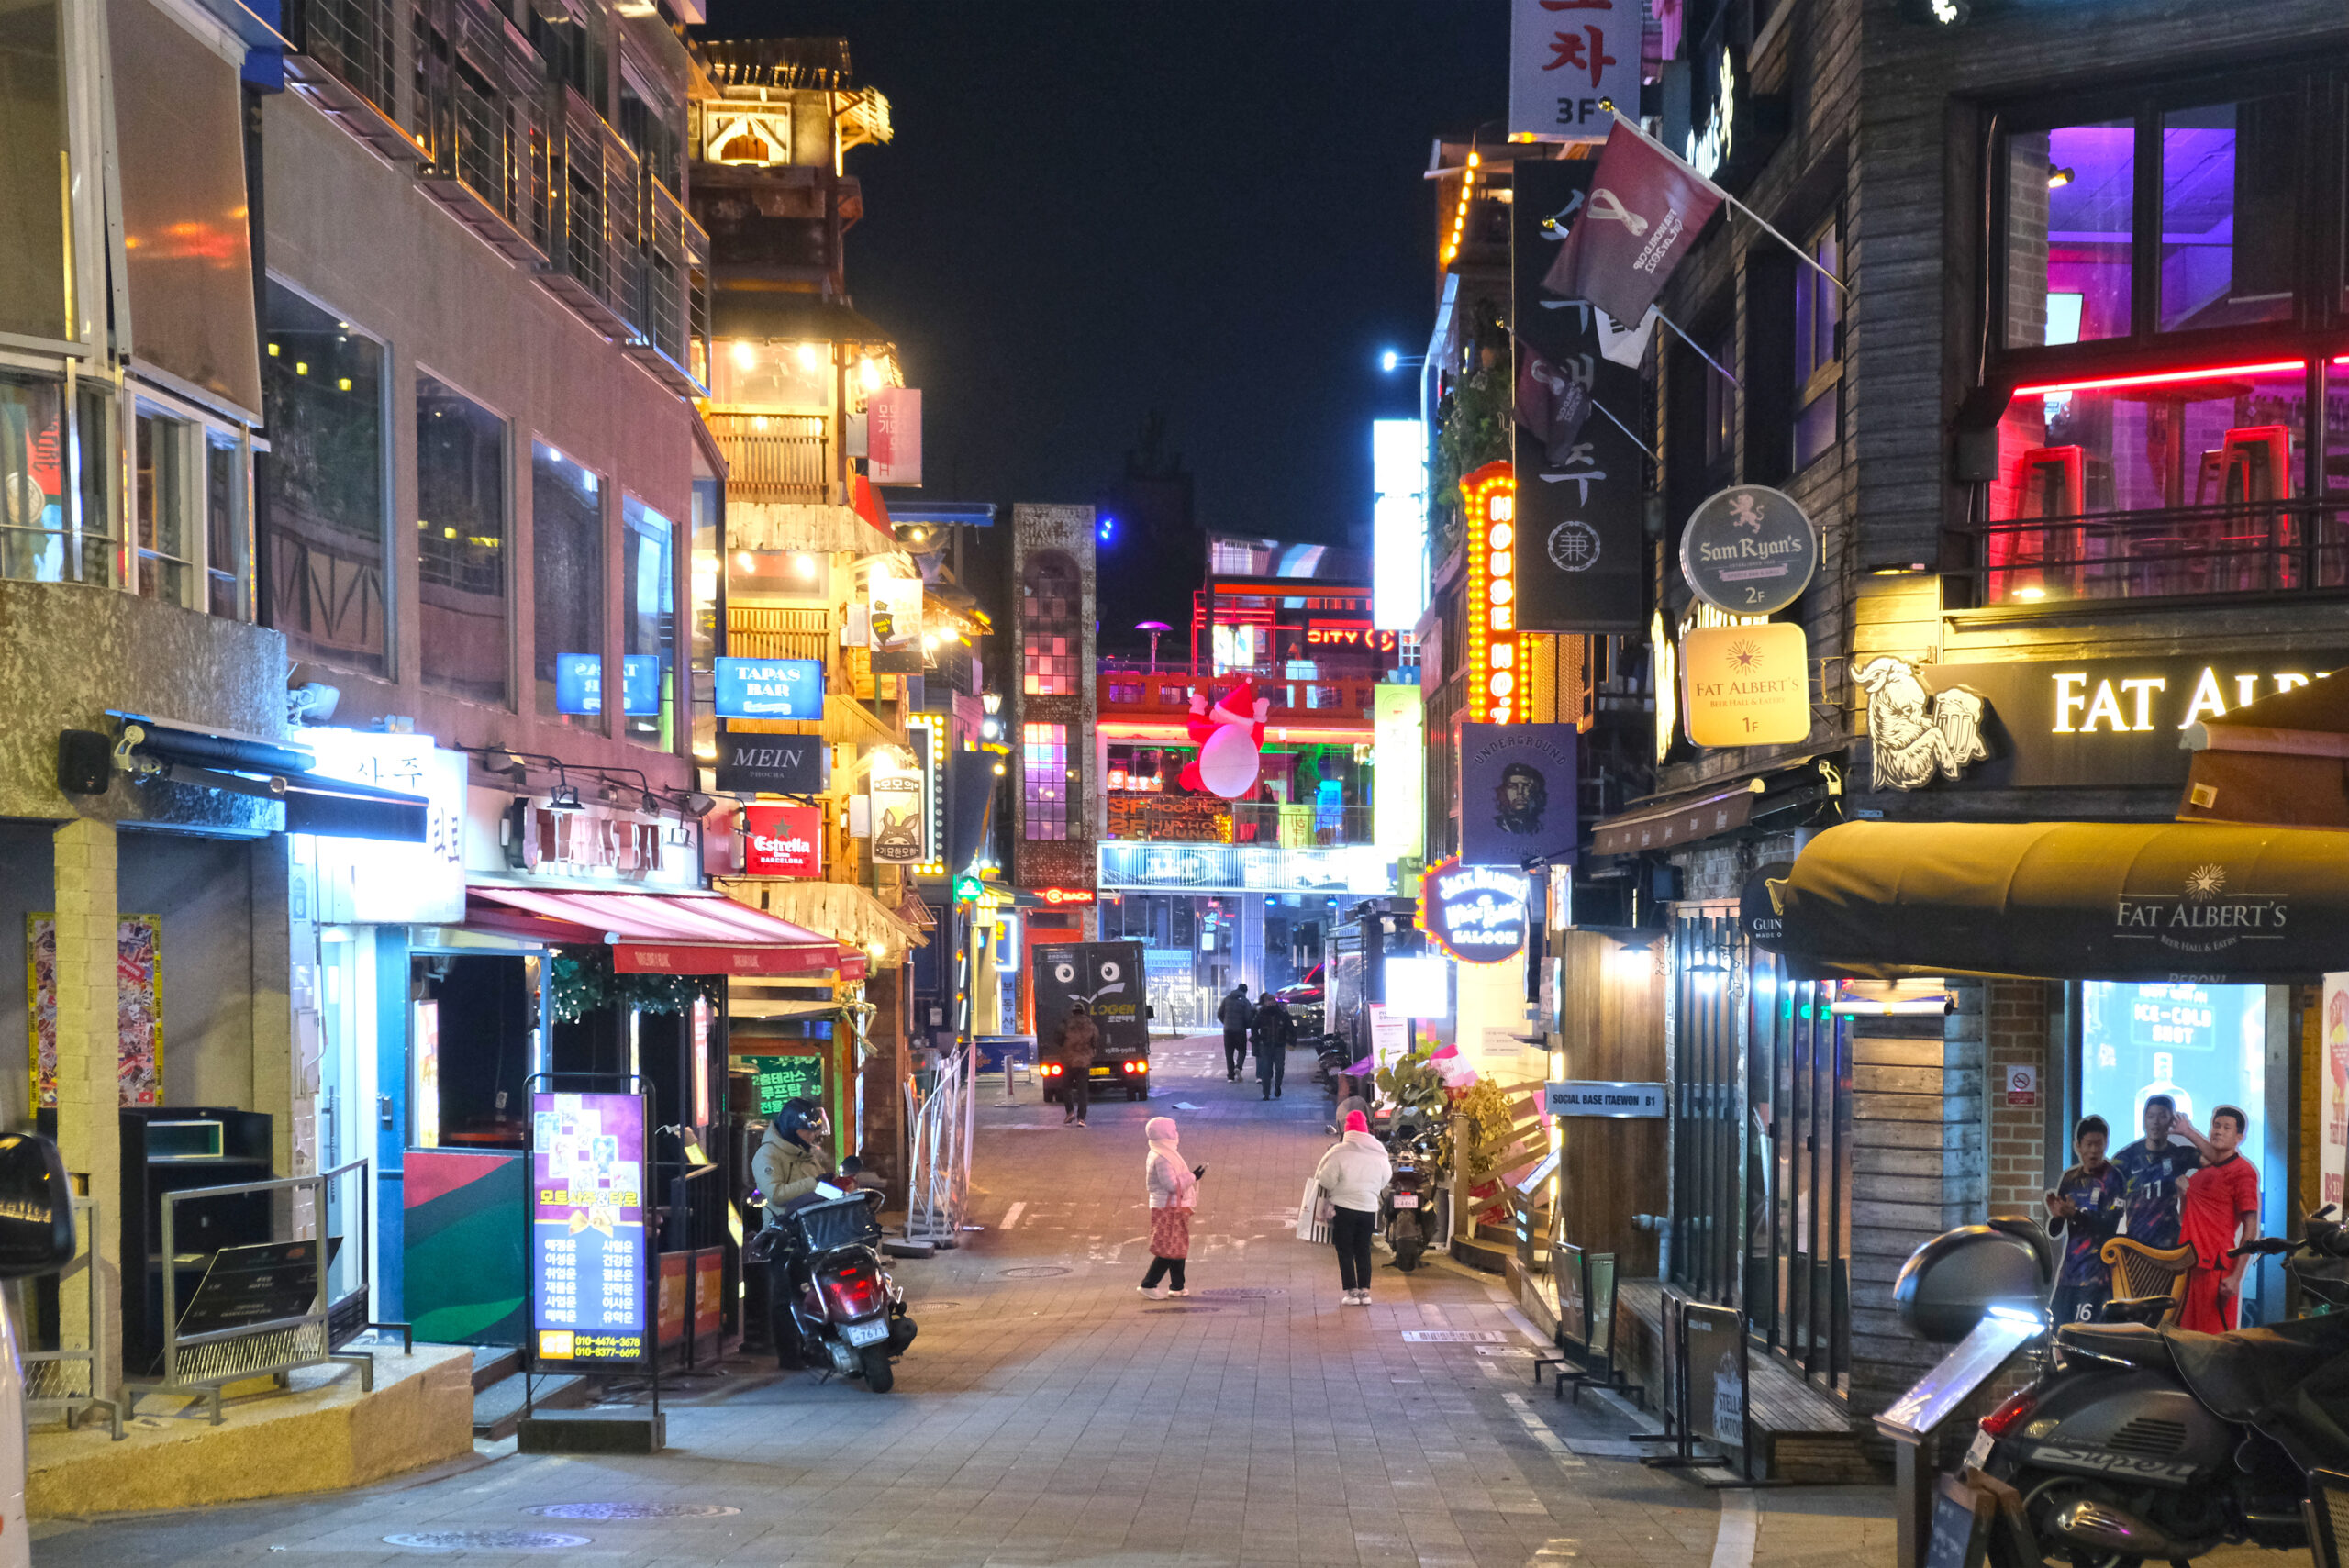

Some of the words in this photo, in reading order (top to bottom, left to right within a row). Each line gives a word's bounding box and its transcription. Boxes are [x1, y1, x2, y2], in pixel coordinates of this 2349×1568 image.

[1539, 0, 1617, 89] 차
[1555, 97, 1597, 125] 3F
[1700, 542, 1738, 562] Sam
[1740, 535, 1802, 560] Ryan's
[1490, 495, 1513, 631] HOUSE
[1745, 587, 1765, 604] 2F
[1308, 630, 1358, 644] CITY
[736, 666, 801, 682] TAPAS
[747, 683, 790, 697] BAR
[1696, 682, 1724, 697] FAT
[1729, 676, 1799, 695] ALBERT'S
[1751, 697, 1757, 706] &
[2052, 672, 2165, 733] FAT
[1742, 717, 1759, 733] 1F
[733, 748, 804, 768] MEIN
[1474, 736, 1567, 766] UNDERGROUND
[357, 756, 423, 789] 사주
[1108, 798, 1147, 814] 3F
[1152, 803, 1226, 814] ROOFTOP
[1108, 818, 1146, 834] 2F
[1152, 829, 1219, 839] LOUNG
[754, 836, 810, 852] Estrella
[1063, 893, 1093, 901] BACK
[2117, 902, 2163, 927] FAT
[2169, 900, 2288, 928] ALBERT'S
[1452, 930, 1518, 944] SALOON
[2160, 934, 2179, 951] BEER
[2181, 942, 2202, 952] HALL
[2204, 943, 2211, 951] &
[1090, 1004, 1136, 1015] LOGEN
[2134, 1003, 2212, 1028] ICE-COLD
[2153, 1024, 2194, 1045] SHOT
[761, 1084, 802, 1099] 루프탑
[1553, 1094, 1580, 1105] SOCIAL
[1582, 1095, 1602, 1105] BASE
[1605, 1095, 1639, 1106] ITAEWON
[1646, 1096, 1655, 1106] B1
[2143, 1180, 2161, 1199] 11
[545, 1253, 576, 1266] 이성운
[602, 1254, 634, 1267] 건강운
[545, 1267, 576, 1280] 취업운
[545, 1296, 576, 1308] 사업운
[602, 1296, 634, 1309] 이사운
[602, 1310, 634, 1324] 유학운
[2076, 1303, 2093, 1321] 16
[575, 1336, 640, 1347] 010-4474-3678
[575, 1347, 640, 1358] 010-8377-6699
